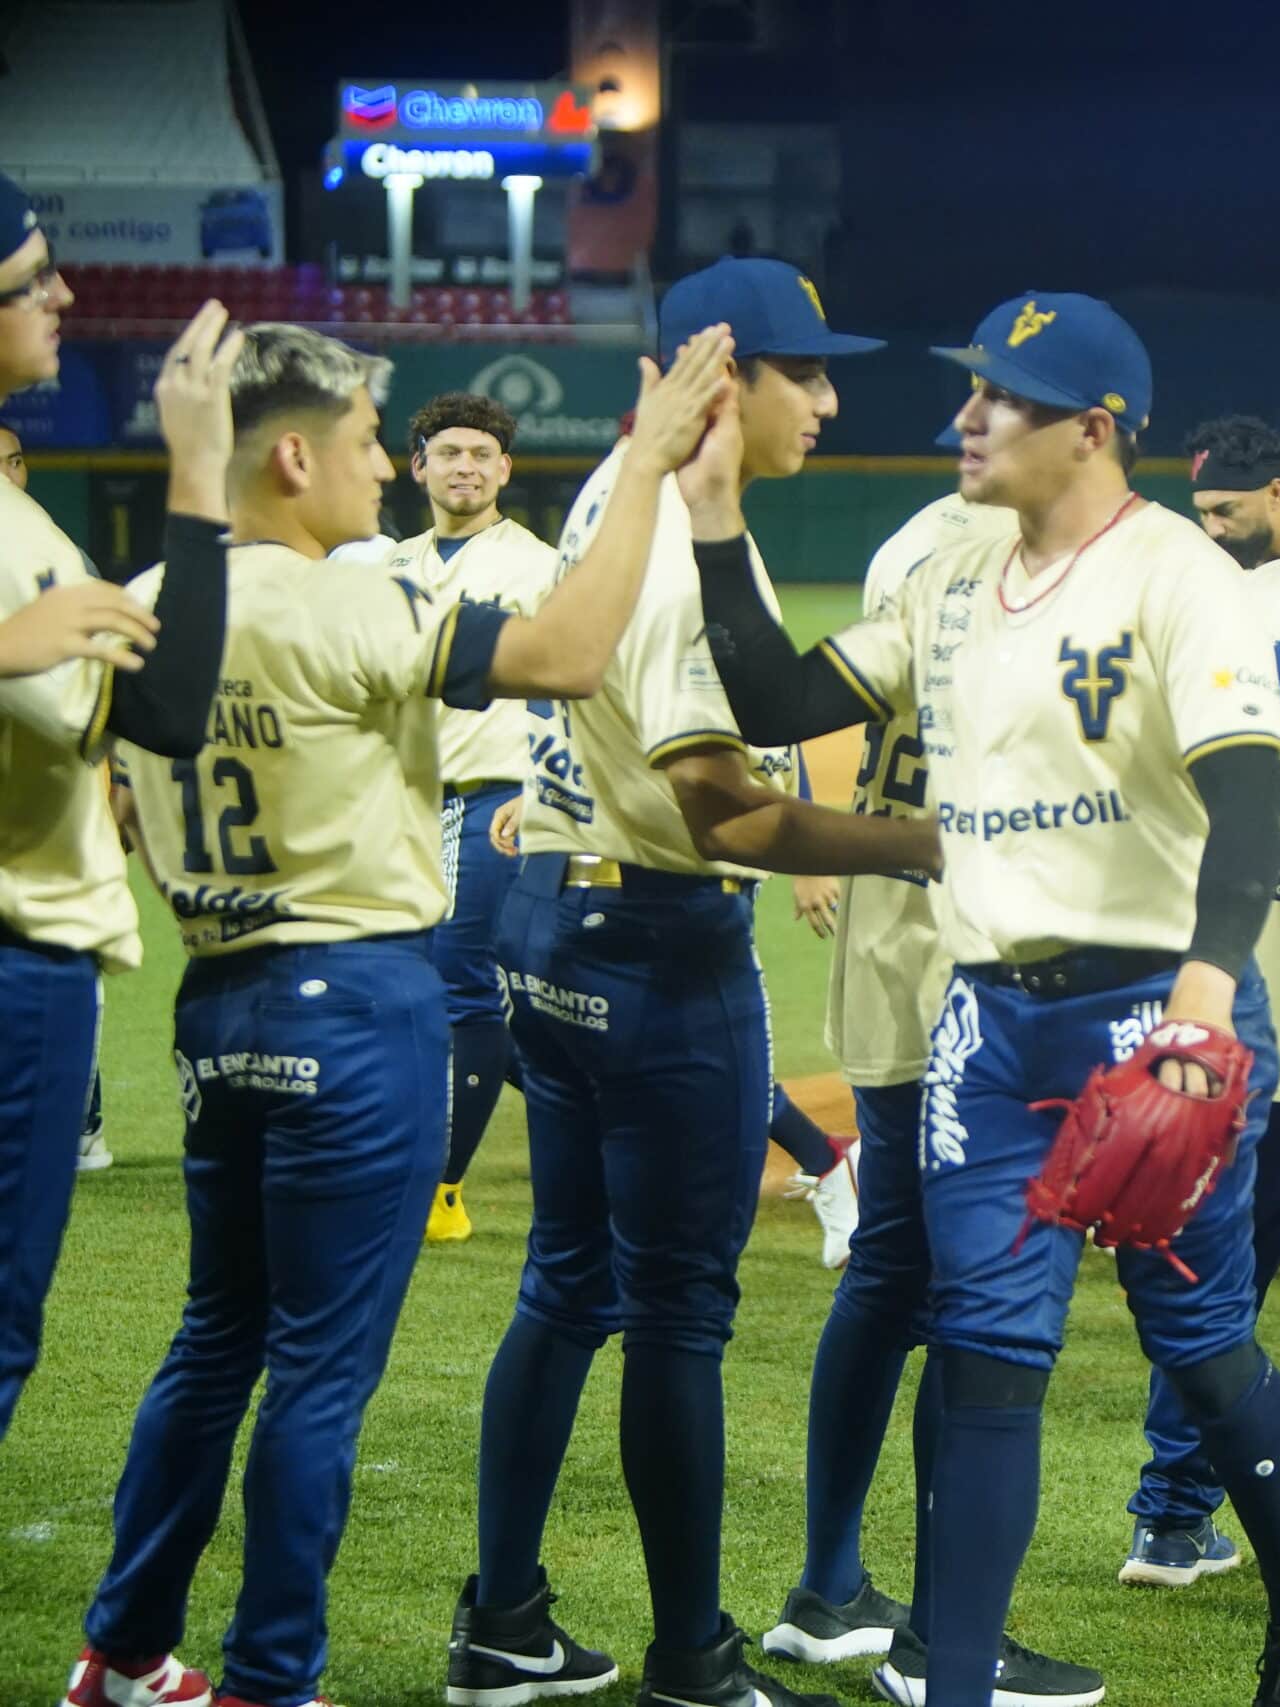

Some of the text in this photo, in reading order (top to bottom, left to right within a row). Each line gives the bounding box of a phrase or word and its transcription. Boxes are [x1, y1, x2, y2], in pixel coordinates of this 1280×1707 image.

[403, 92, 543, 128] Chevron
[361, 143, 494, 179] Chevron
[68, 216, 172, 242] contigo
[171, 756, 280, 875] 12
[509, 971, 609, 1015] EL ENCANTO
[197, 1052, 320, 1080] EL ENCANTO
